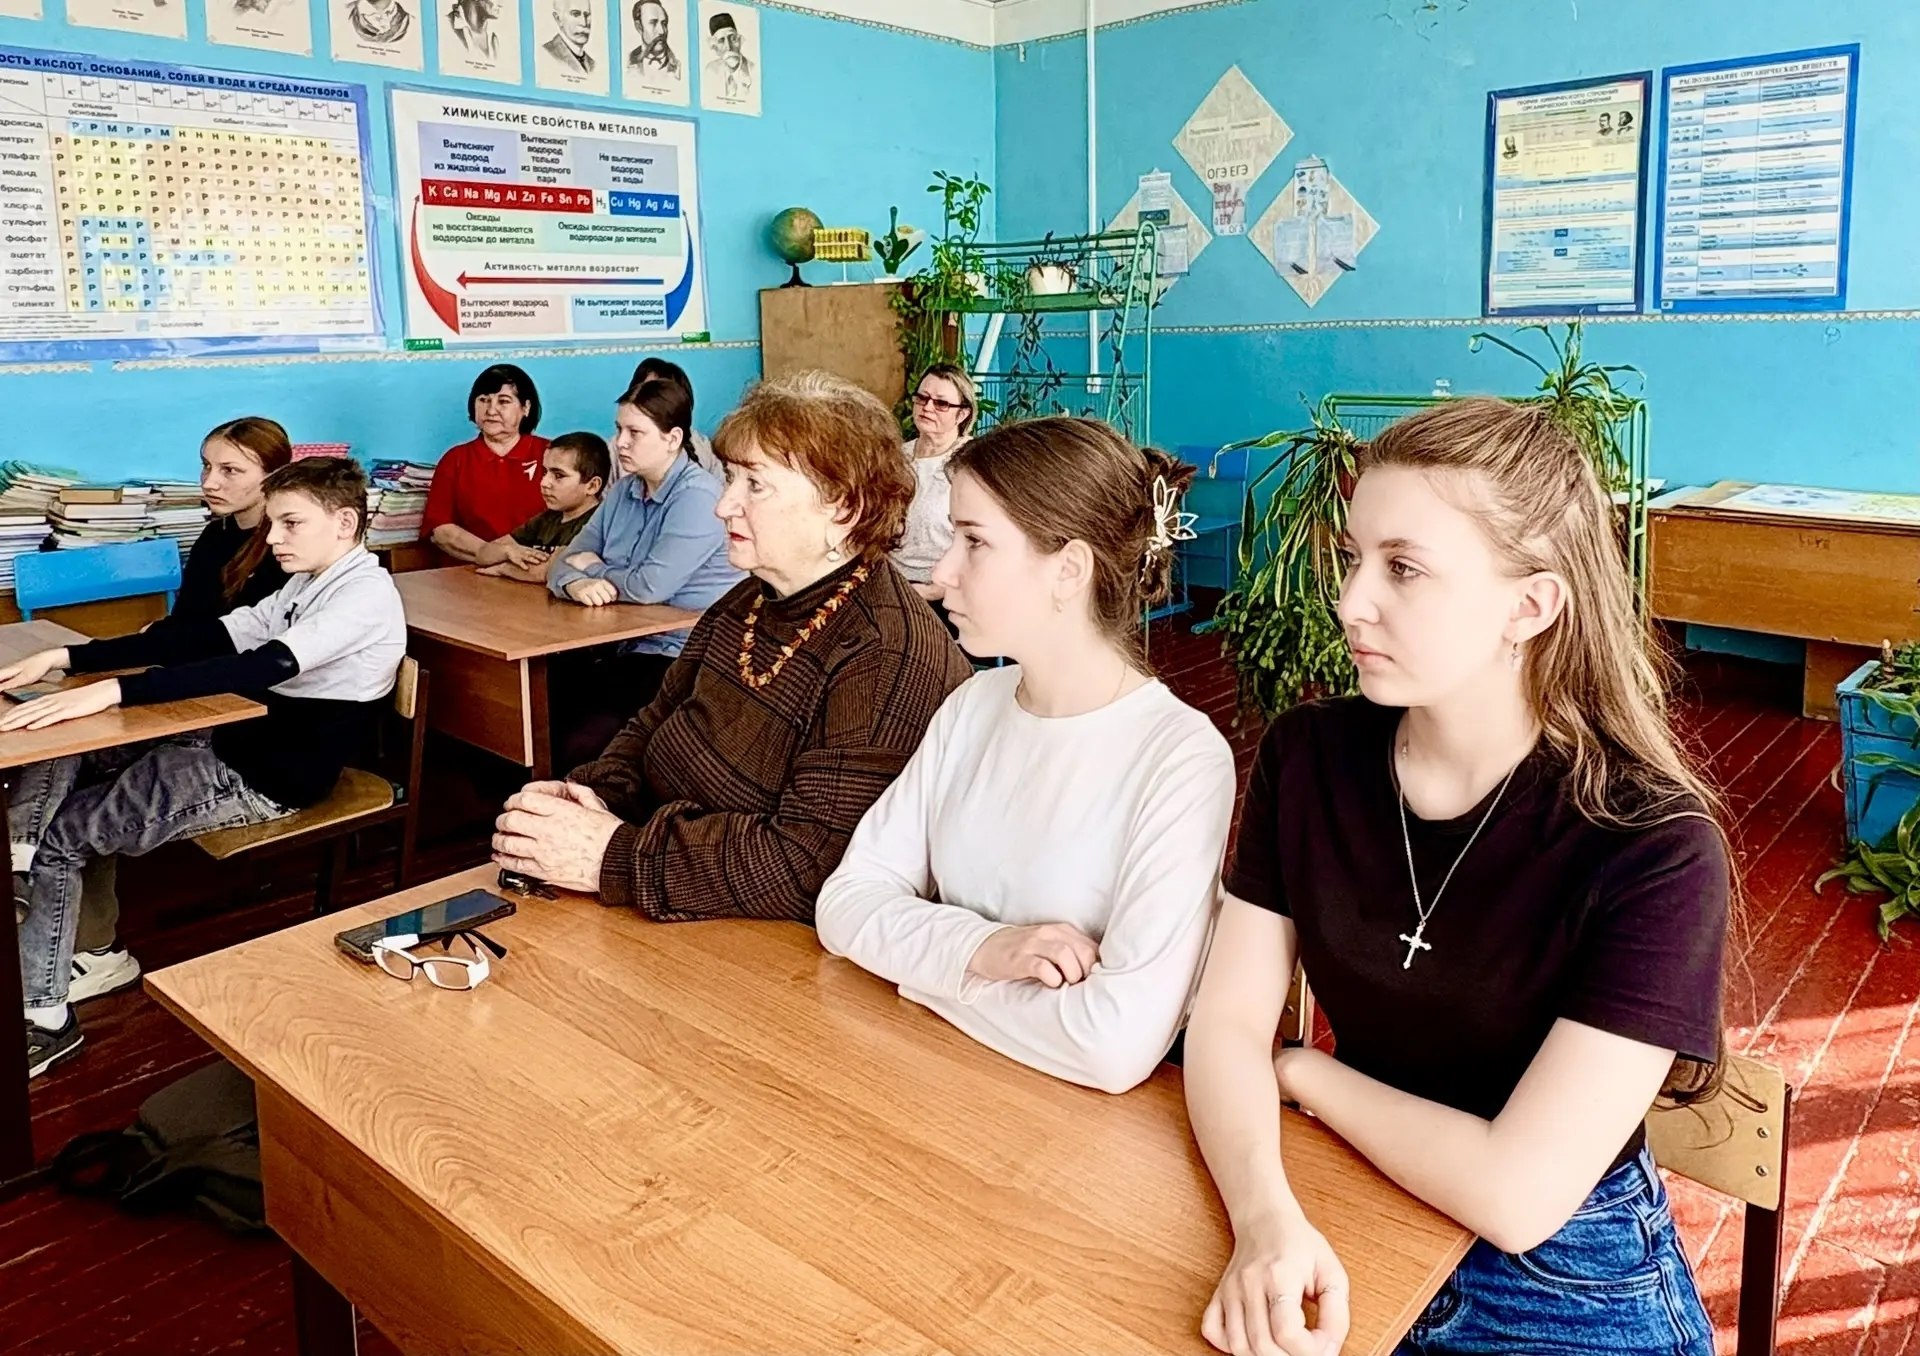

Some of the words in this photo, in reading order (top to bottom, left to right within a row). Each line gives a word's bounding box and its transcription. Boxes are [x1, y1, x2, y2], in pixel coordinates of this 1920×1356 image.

[0, 54, 31, 66] ОСТЬ
[34, 58, 88, 72] КИСЛОТ,
[90, 64, 166, 80] ОСНОВАНИЙ,
[168, 72, 204, 84] СОЛЕЙ
[218, 78, 246, 88] ВОДЕ
[250, 80, 256, 88] И
[258, 80, 292, 92] СРЕДА
[294, 85, 350, 98] РАСТВОРОВ
[442, 106, 528, 124] ХИМИЧЕСКИЕ
[532, 116, 595, 130] СВОЙСТВА
[598, 123, 658, 137] МЕТАЛЛОВ
[443, 138, 495, 151] Вытесняют
[520, 134, 568, 146] Вытесняют
[450, 152, 490, 164] водород
[532, 156, 560, 164] только
[599, 153, 610, 162] Не
[482, 166, 506, 174] воды
[610, 166, 644, 176] водород
[1207, 168, 1228, 180] ОГЭ
[1230, 164, 1248, 177] ЕГЭ
[428, 186, 437, 196] K
[444, 187, 458, 198] Ca
[464, 188, 479, 200] Na
[484, 189, 501, 202] Mg
[506, 190, 517, 200] Al
[522, 192, 536, 202] Zn
[540, 192, 554, 204] Fe
[559, 194, 572, 204] Sn
[577, 194, 590, 206] Pb
[610, 196, 624, 206] Cu
[628, 198, 641, 210] Hg
[646, 199, 658, 210] Ag
[663, 200, 674, 210] Au
[466, 212, 501, 222] Оксиды
[558, 222, 590, 231] Оксиды
[4, 234, 48, 244] фосфат
[432, 234, 484, 244] водородом
[484, 262, 544, 270] Активность
[460, 298, 510, 306] Вытесняют
[512, 300, 549, 308] водород
[474, 308, 536, 318] разбавленных
